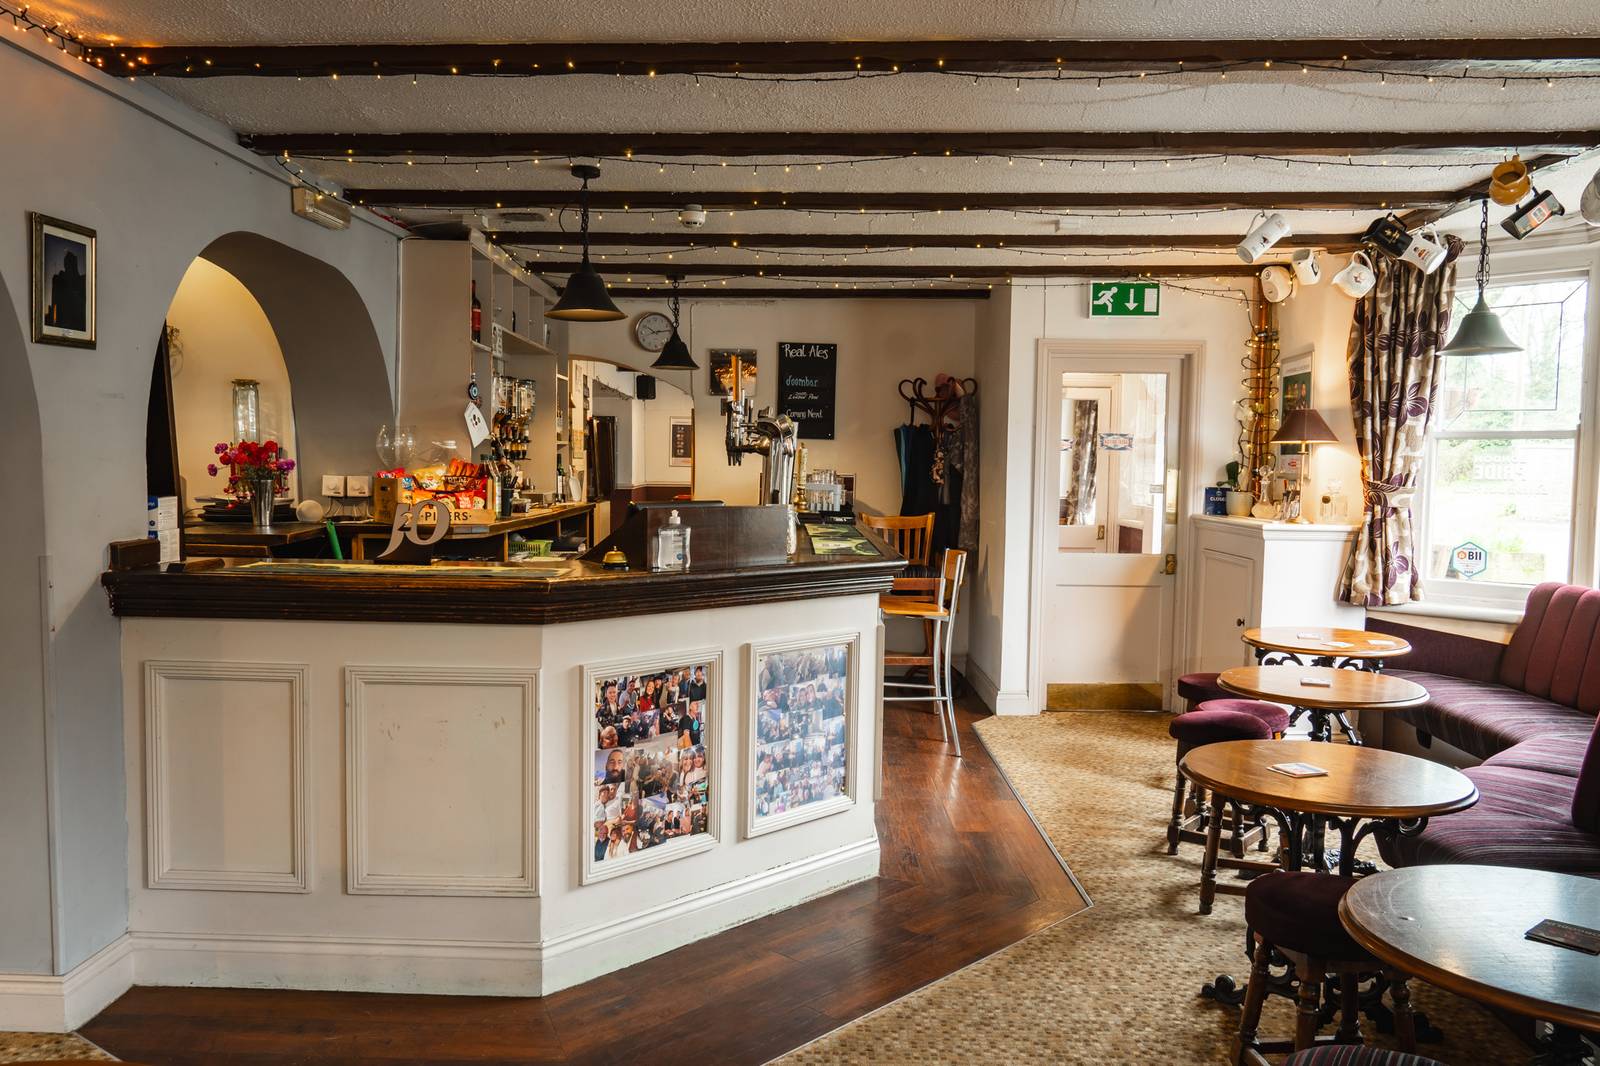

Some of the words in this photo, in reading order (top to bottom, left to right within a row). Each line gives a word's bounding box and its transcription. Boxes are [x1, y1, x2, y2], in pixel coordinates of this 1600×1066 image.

[784, 344, 806, 357] Real
[809, 345, 829, 360] Ales
[424, 511, 469, 521] PIERS
